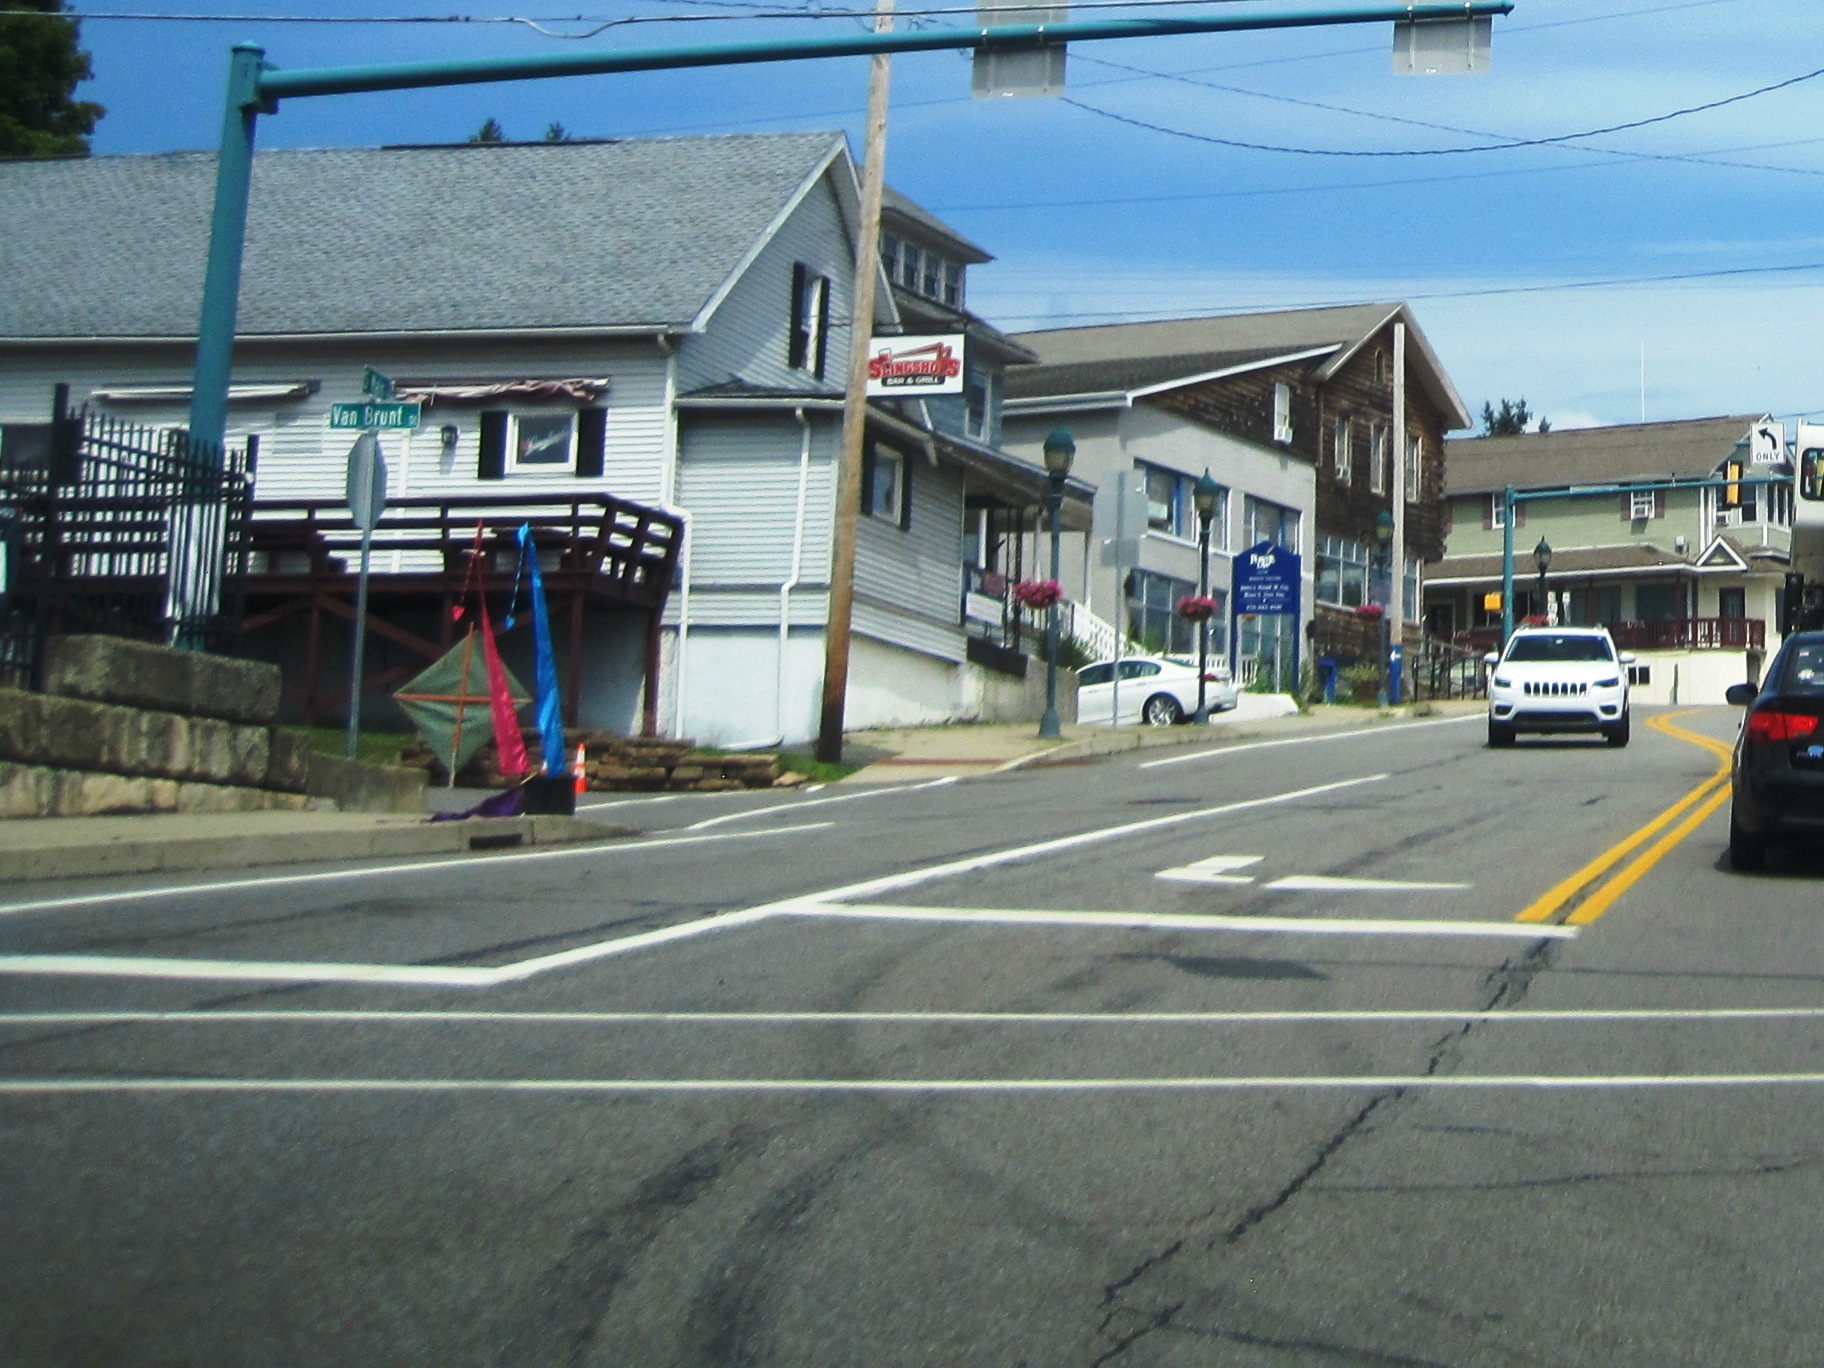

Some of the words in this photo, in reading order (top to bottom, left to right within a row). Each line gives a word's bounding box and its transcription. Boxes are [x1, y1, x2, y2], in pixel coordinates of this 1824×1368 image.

[886, 376, 903, 385] BAR
[915, 375, 940, 385] GRILL
[333, 406, 357, 425] Van
[364, 405, 403, 425] Brunt
[1756, 452, 1780, 461] ONLY
